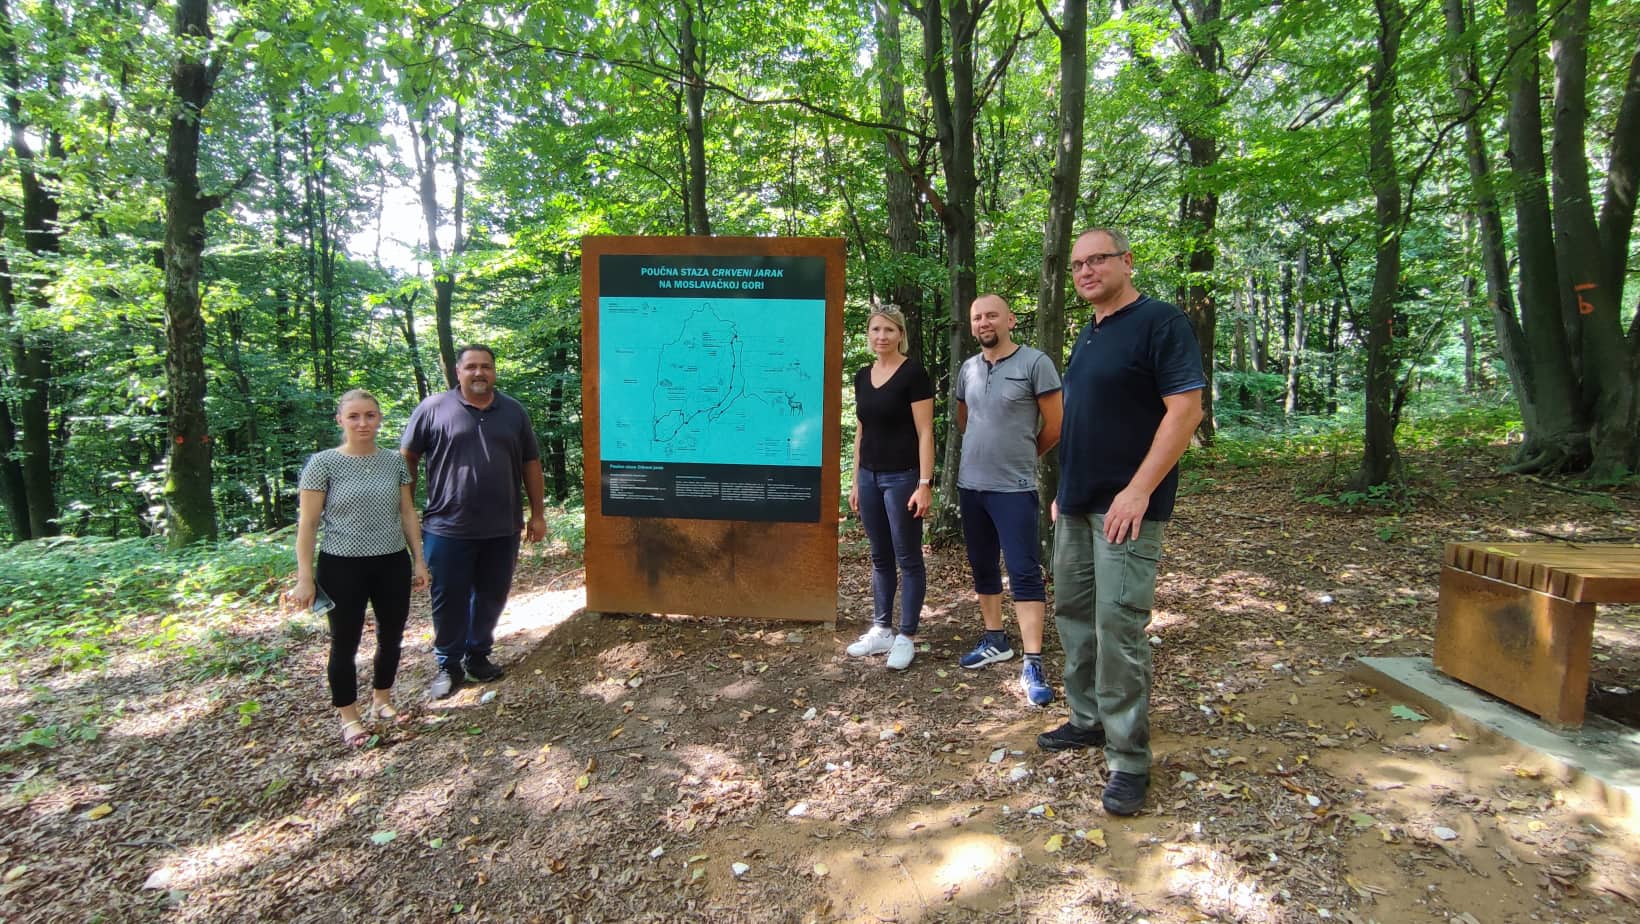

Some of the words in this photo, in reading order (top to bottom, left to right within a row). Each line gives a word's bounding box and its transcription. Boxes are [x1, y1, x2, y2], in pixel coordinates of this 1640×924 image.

[641, 266, 678, 276] POUČNA
[681, 268, 709, 277] STAZA
[712, 268, 752, 277] CRKVENI
[754, 269, 784, 278] JARAK
[659, 279, 672, 289] NA
[674, 279, 739, 289] MOSLAVAČKOJ
[741, 281, 765, 290] GORI
